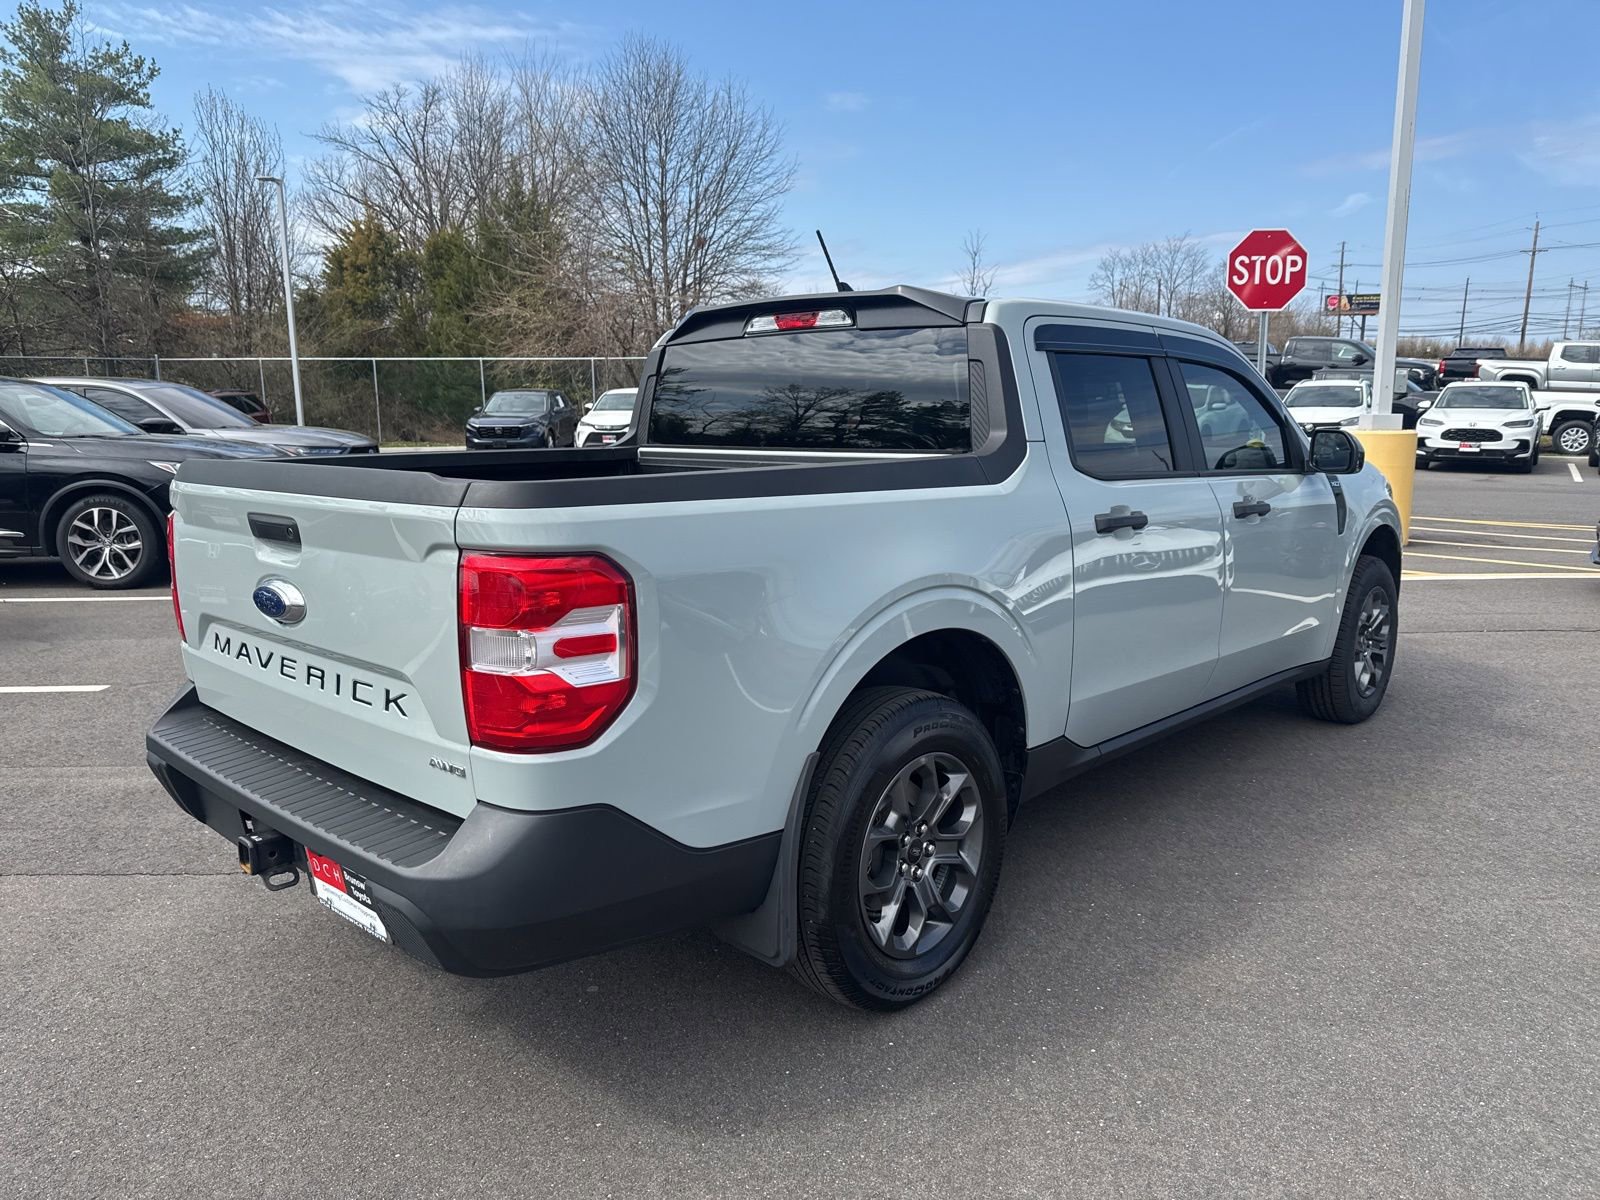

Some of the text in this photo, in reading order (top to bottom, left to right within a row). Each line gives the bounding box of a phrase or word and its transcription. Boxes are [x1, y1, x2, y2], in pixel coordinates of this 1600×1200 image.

[1232, 255, 1303, 285] STOP
[213, 632, 409, 719] MAVERICK
[429, 757, 467, 779] AWD
